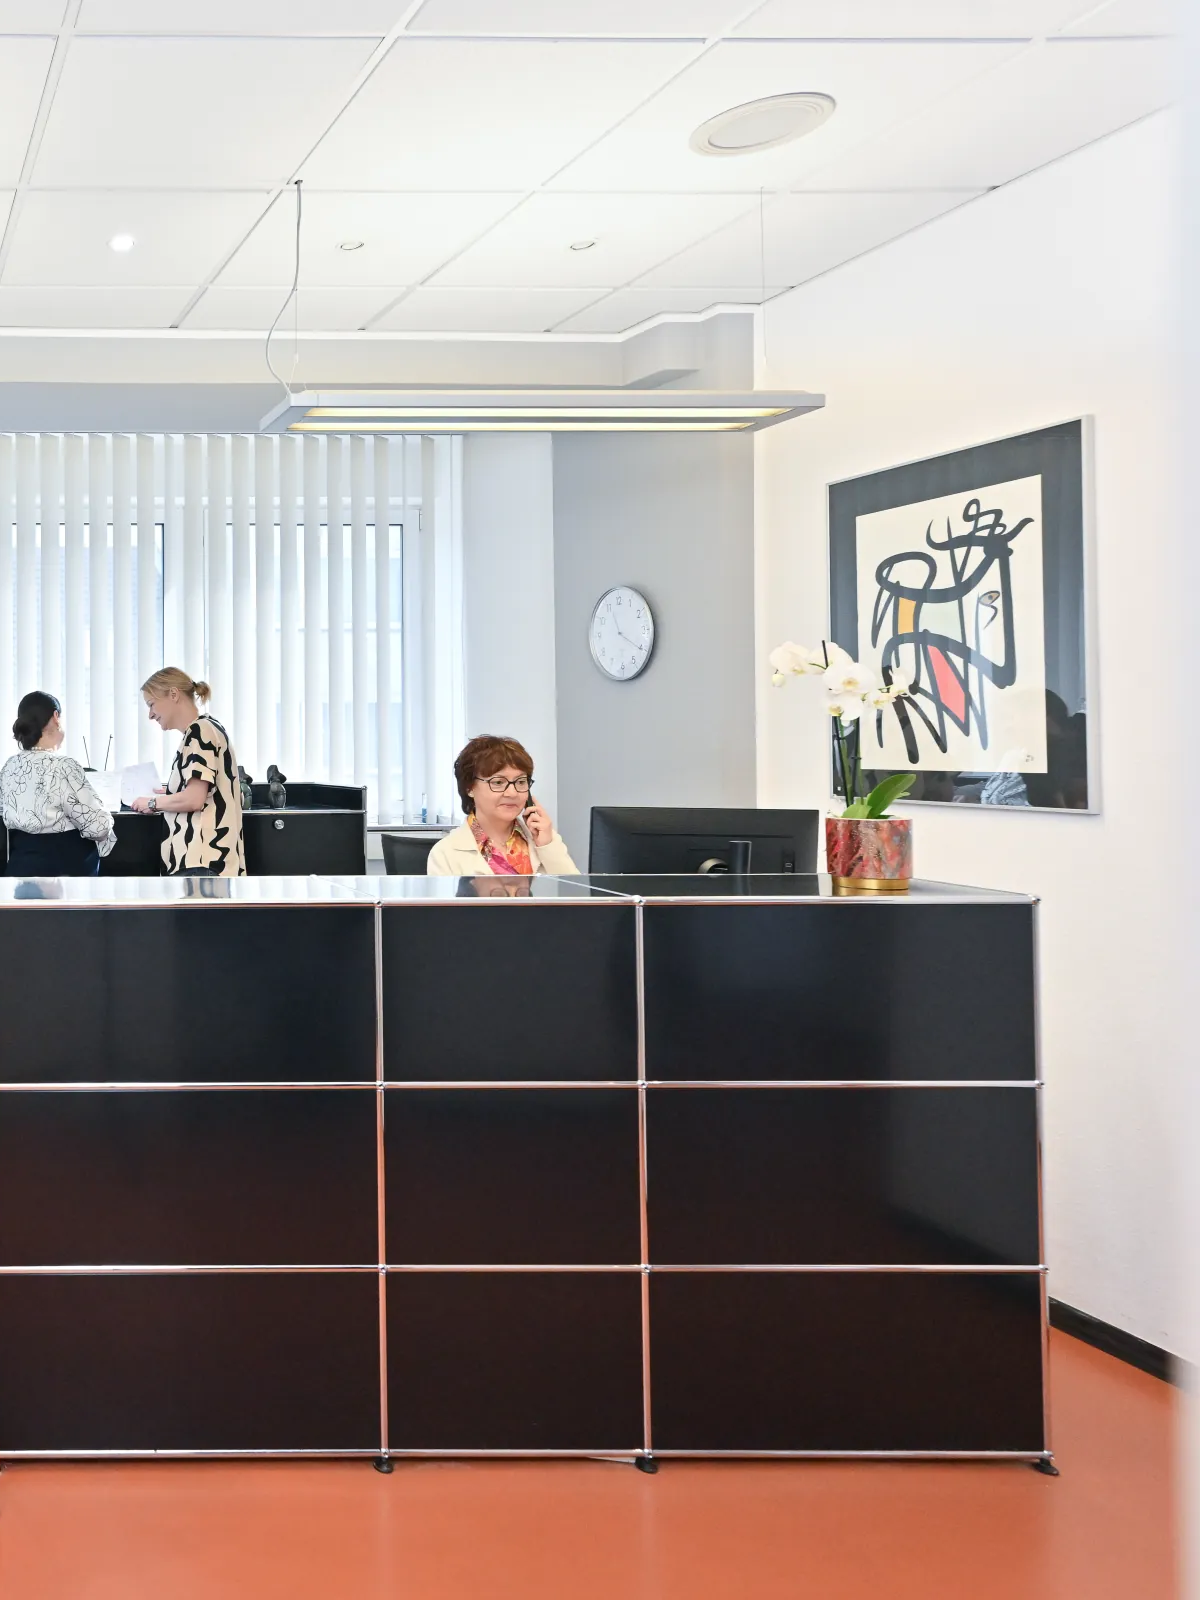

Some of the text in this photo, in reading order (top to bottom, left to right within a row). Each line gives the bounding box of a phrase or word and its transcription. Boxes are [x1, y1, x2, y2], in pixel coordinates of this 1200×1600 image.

[616, 596, 622, 605] 12
[606, 603, 612, 613] 11
[637, 610, 641, 618] 2
[632, 656, 636, 665] 5
